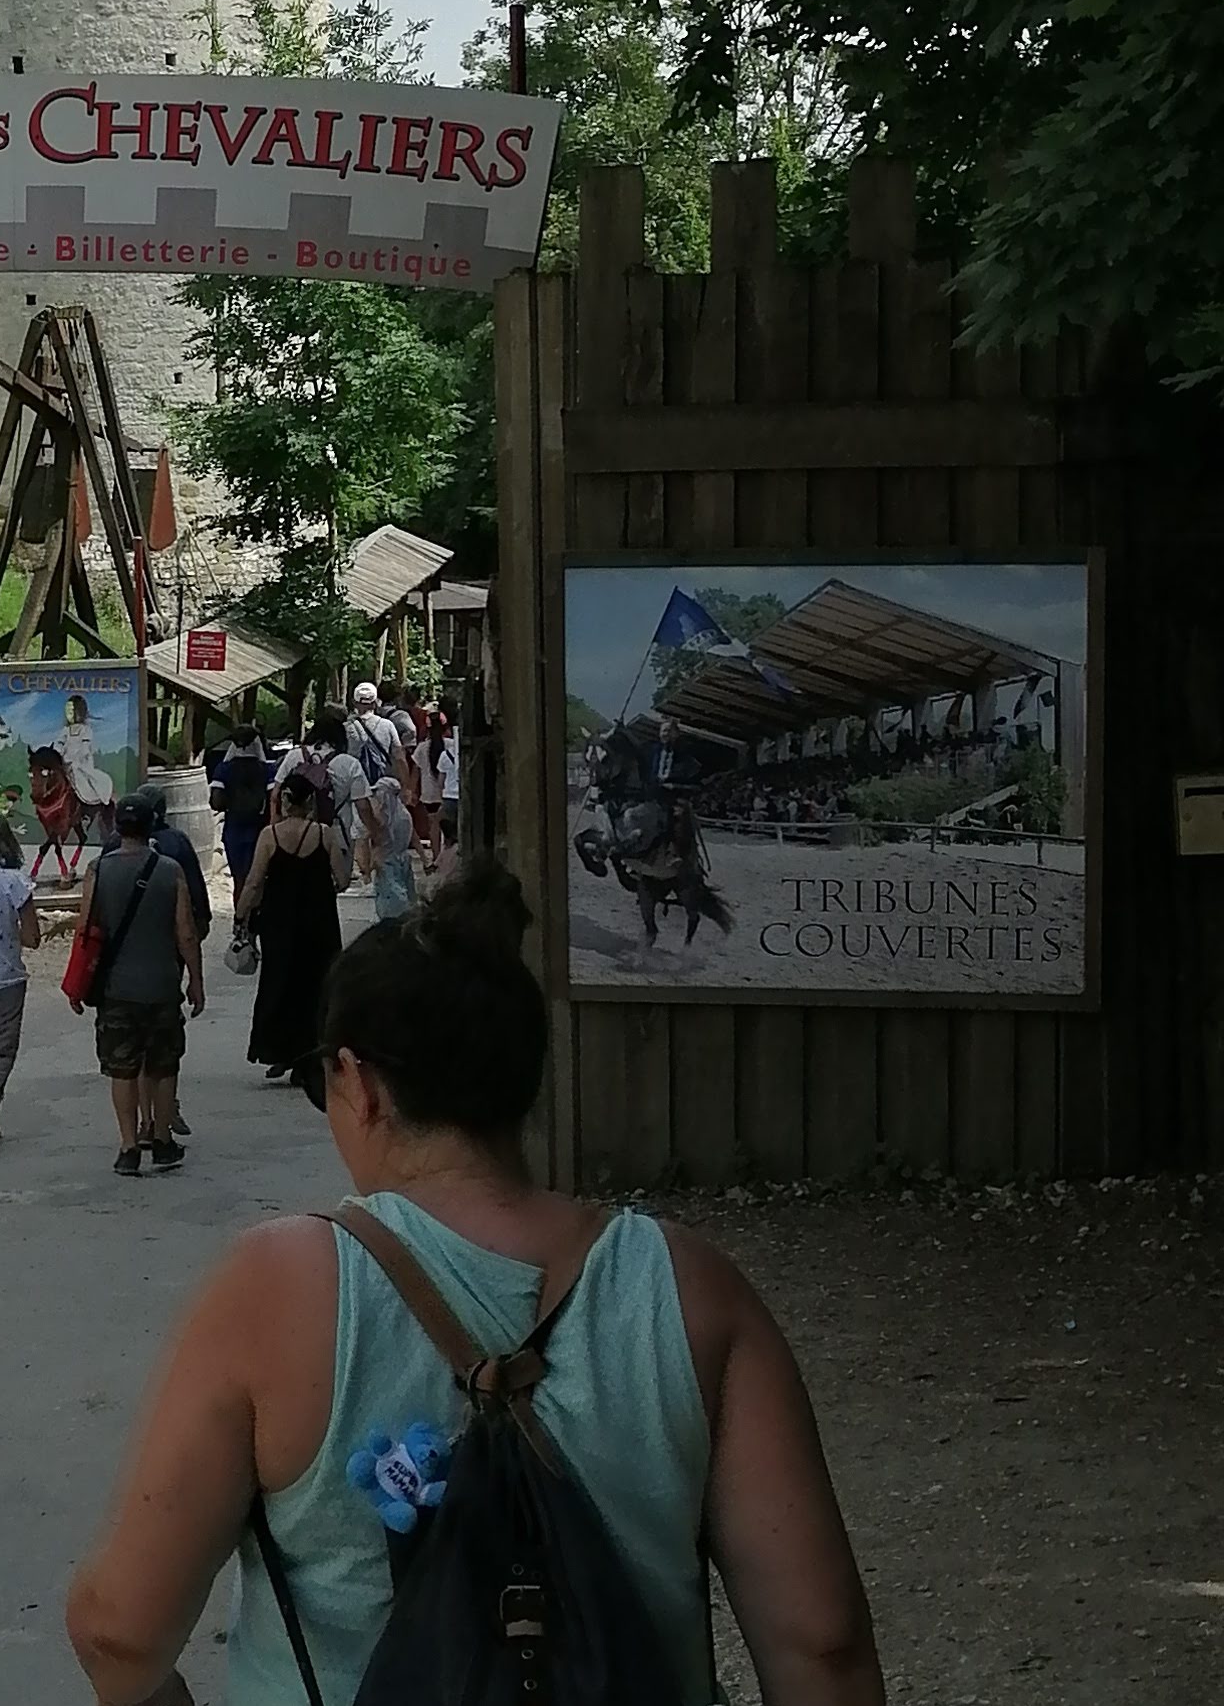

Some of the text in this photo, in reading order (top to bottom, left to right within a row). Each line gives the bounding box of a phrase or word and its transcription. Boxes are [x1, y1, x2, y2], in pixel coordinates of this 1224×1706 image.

[28, 81, 534, 192] CHEVALIERS
[55, 235, 250, 266] Billetterie
[296, 240, 472, 281] Boutique
[8, 673, 132, 694] CHEVALIERS
[781, 878, 1039, 918] TRIBUNES
[759, 922, 1063, 963] COUVERTES
